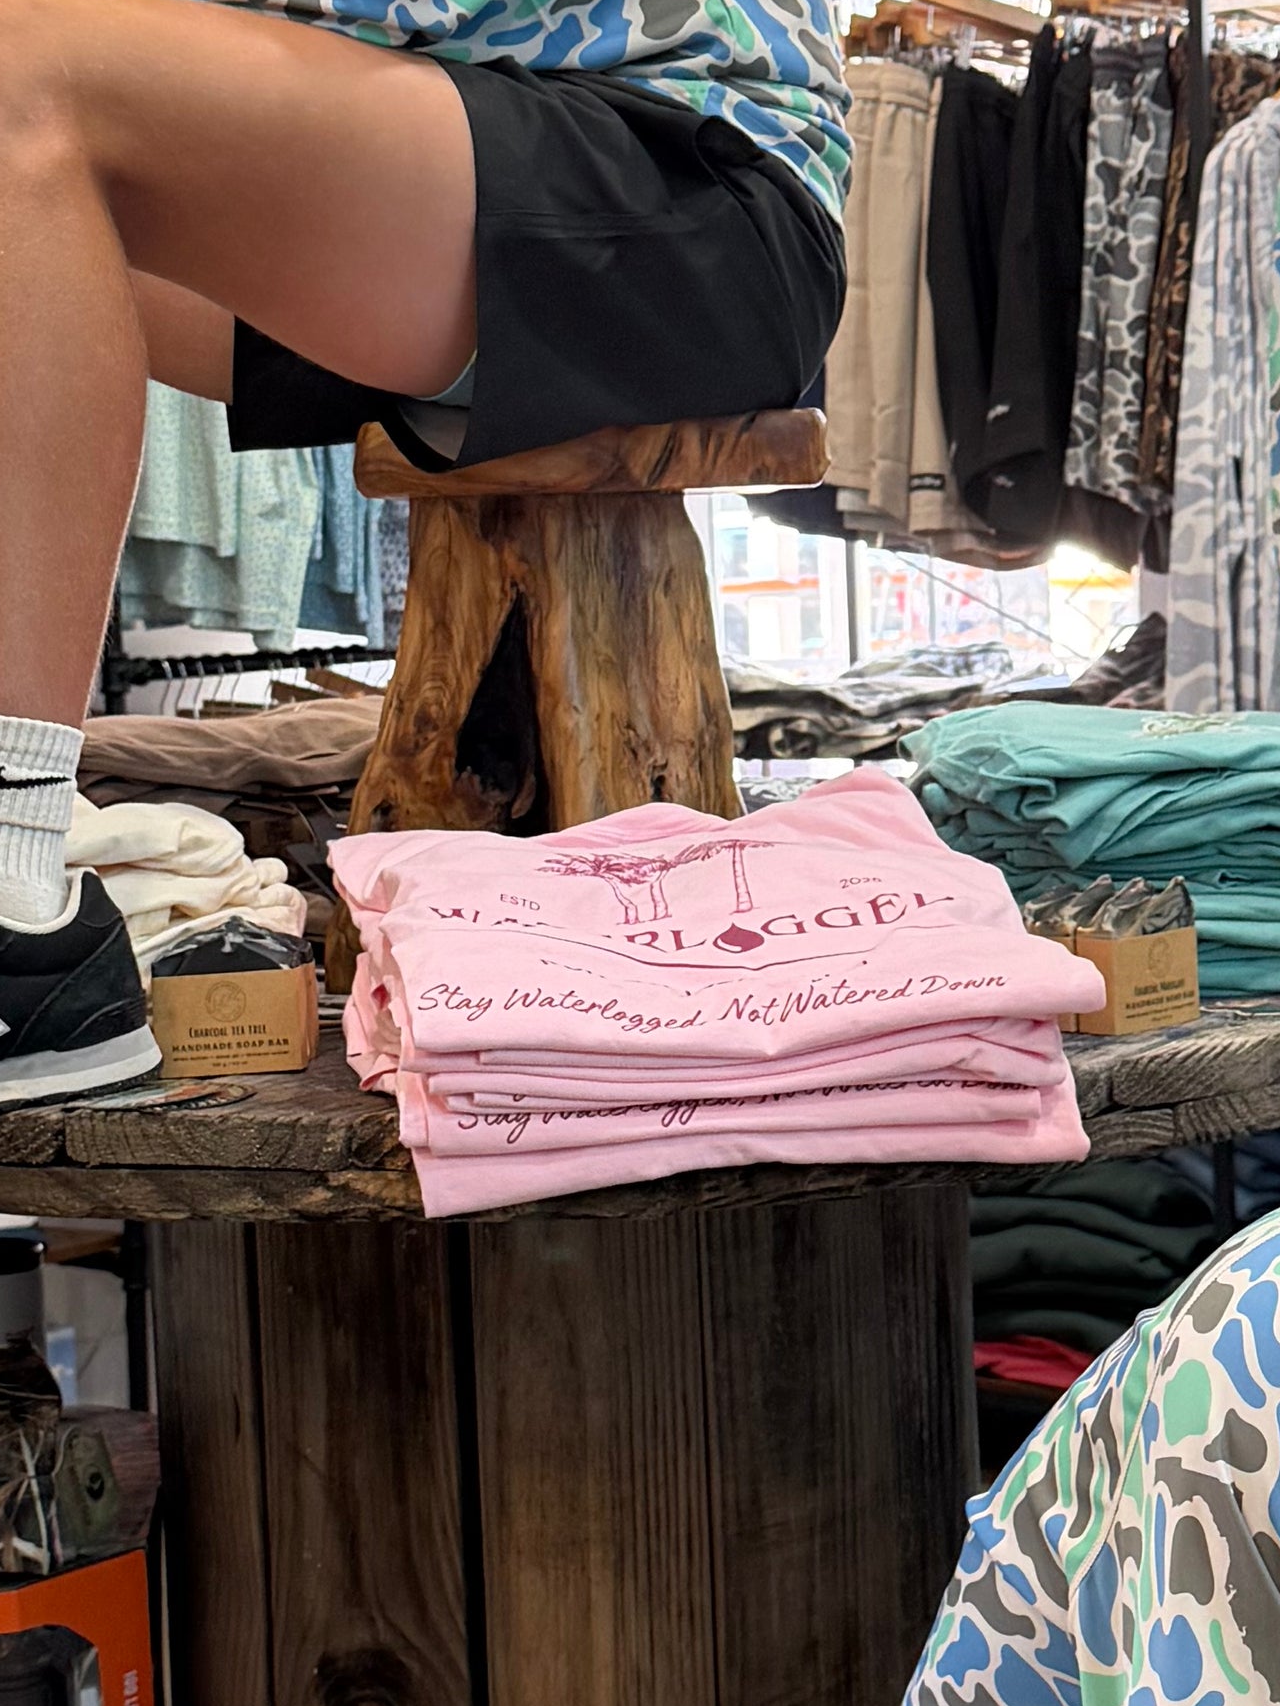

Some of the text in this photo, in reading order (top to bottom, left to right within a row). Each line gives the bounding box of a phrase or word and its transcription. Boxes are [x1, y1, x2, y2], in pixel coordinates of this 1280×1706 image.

[499, 892, 541, 912] ESTD
[418, 983, 494, 1022] Stay
[719, 994, 779, 1027] Not
[779, 977, 915, 1025] Watered
[920, 973, 1007, 994] Down
[172, 1042, 232, 1054] HANDMADE
[236, 1040, 265, 1049] SOAP
